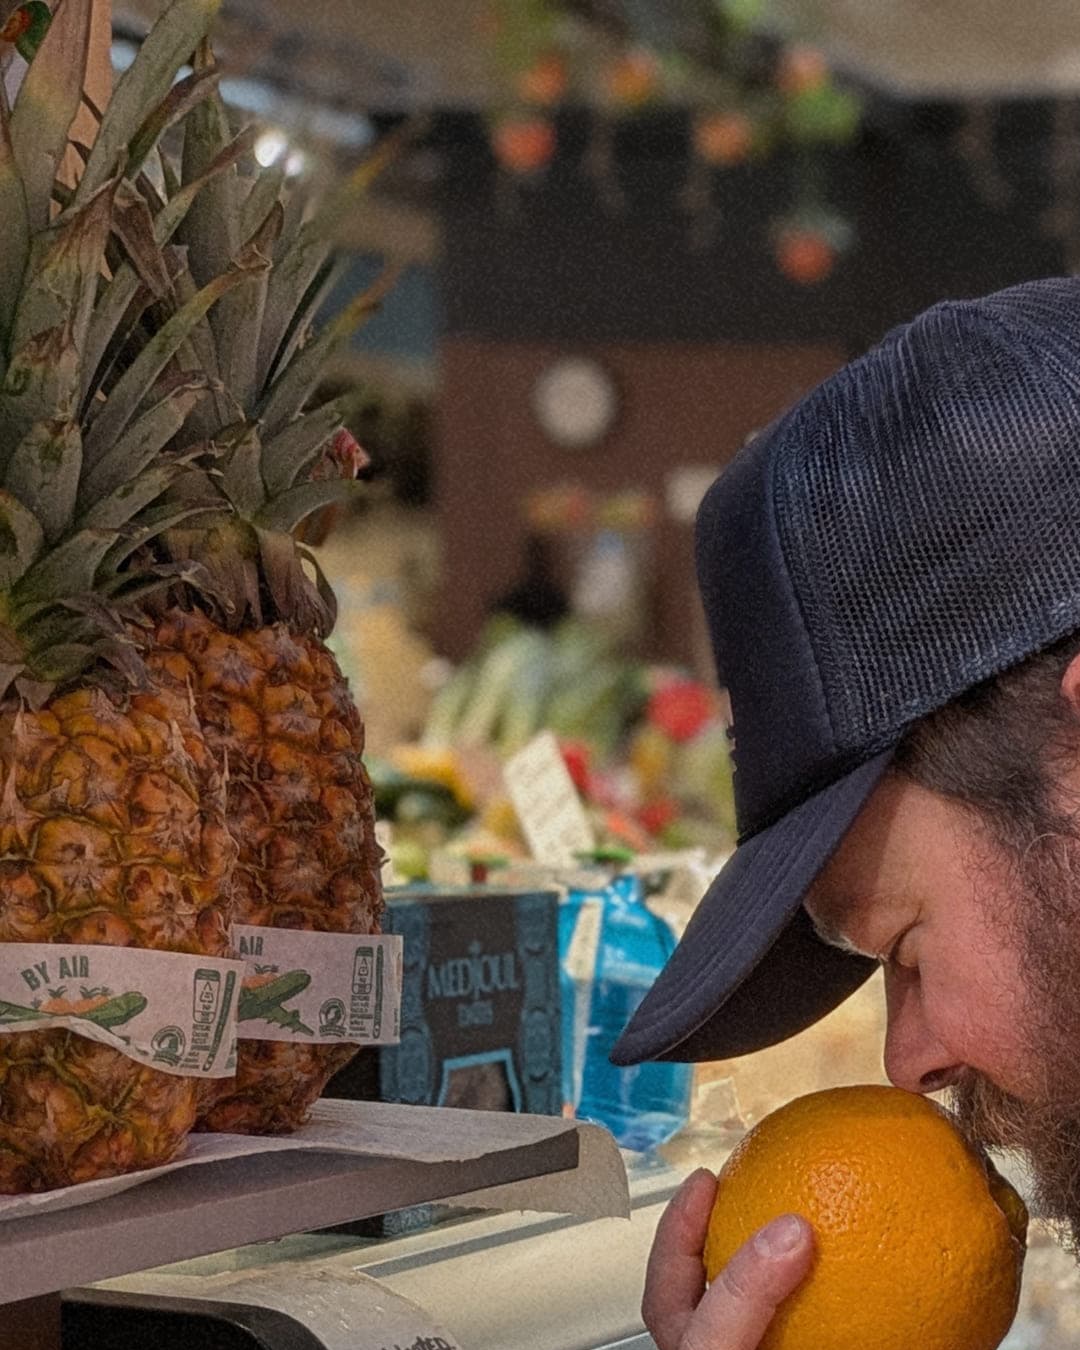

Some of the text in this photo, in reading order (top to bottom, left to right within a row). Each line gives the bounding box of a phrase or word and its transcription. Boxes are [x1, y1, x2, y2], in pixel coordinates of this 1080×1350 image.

[239, 936, 264, 956] AIR
[21, 956, 90, 991] BY AIR
